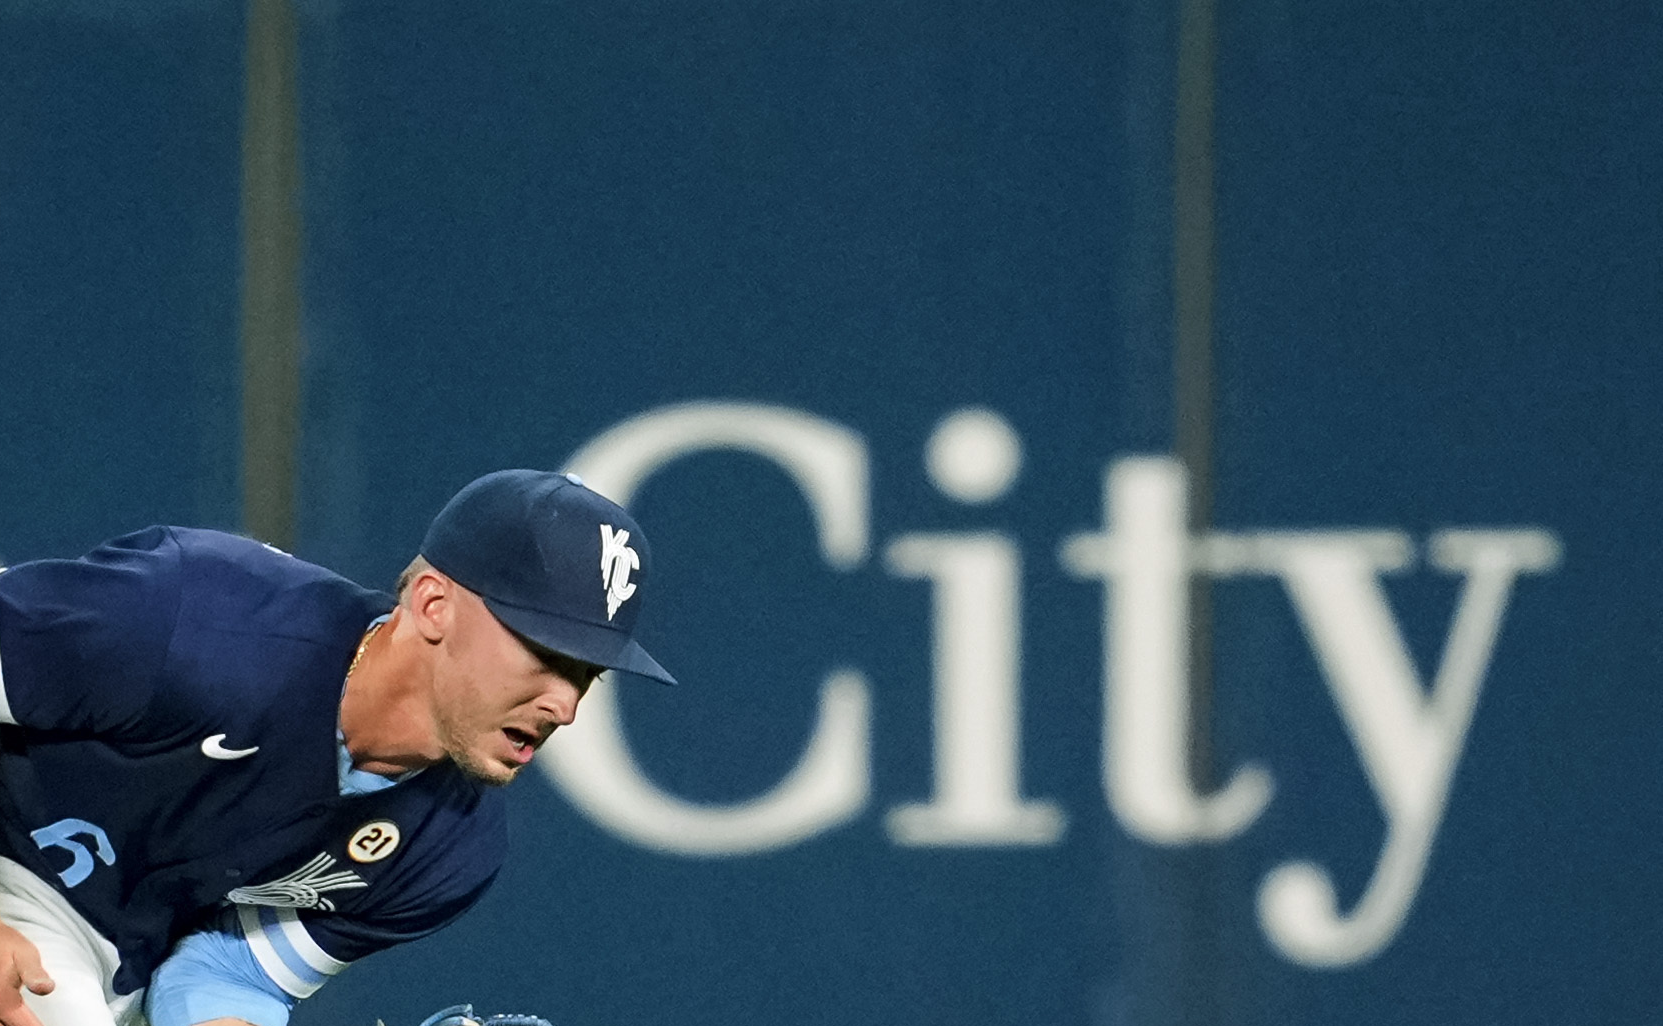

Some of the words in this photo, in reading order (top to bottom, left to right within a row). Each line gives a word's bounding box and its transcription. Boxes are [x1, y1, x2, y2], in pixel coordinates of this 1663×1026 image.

[600, 524, 640, 621] KC
[537, 401, 1561, 967] City
[356, 827, 393, 856] 21
